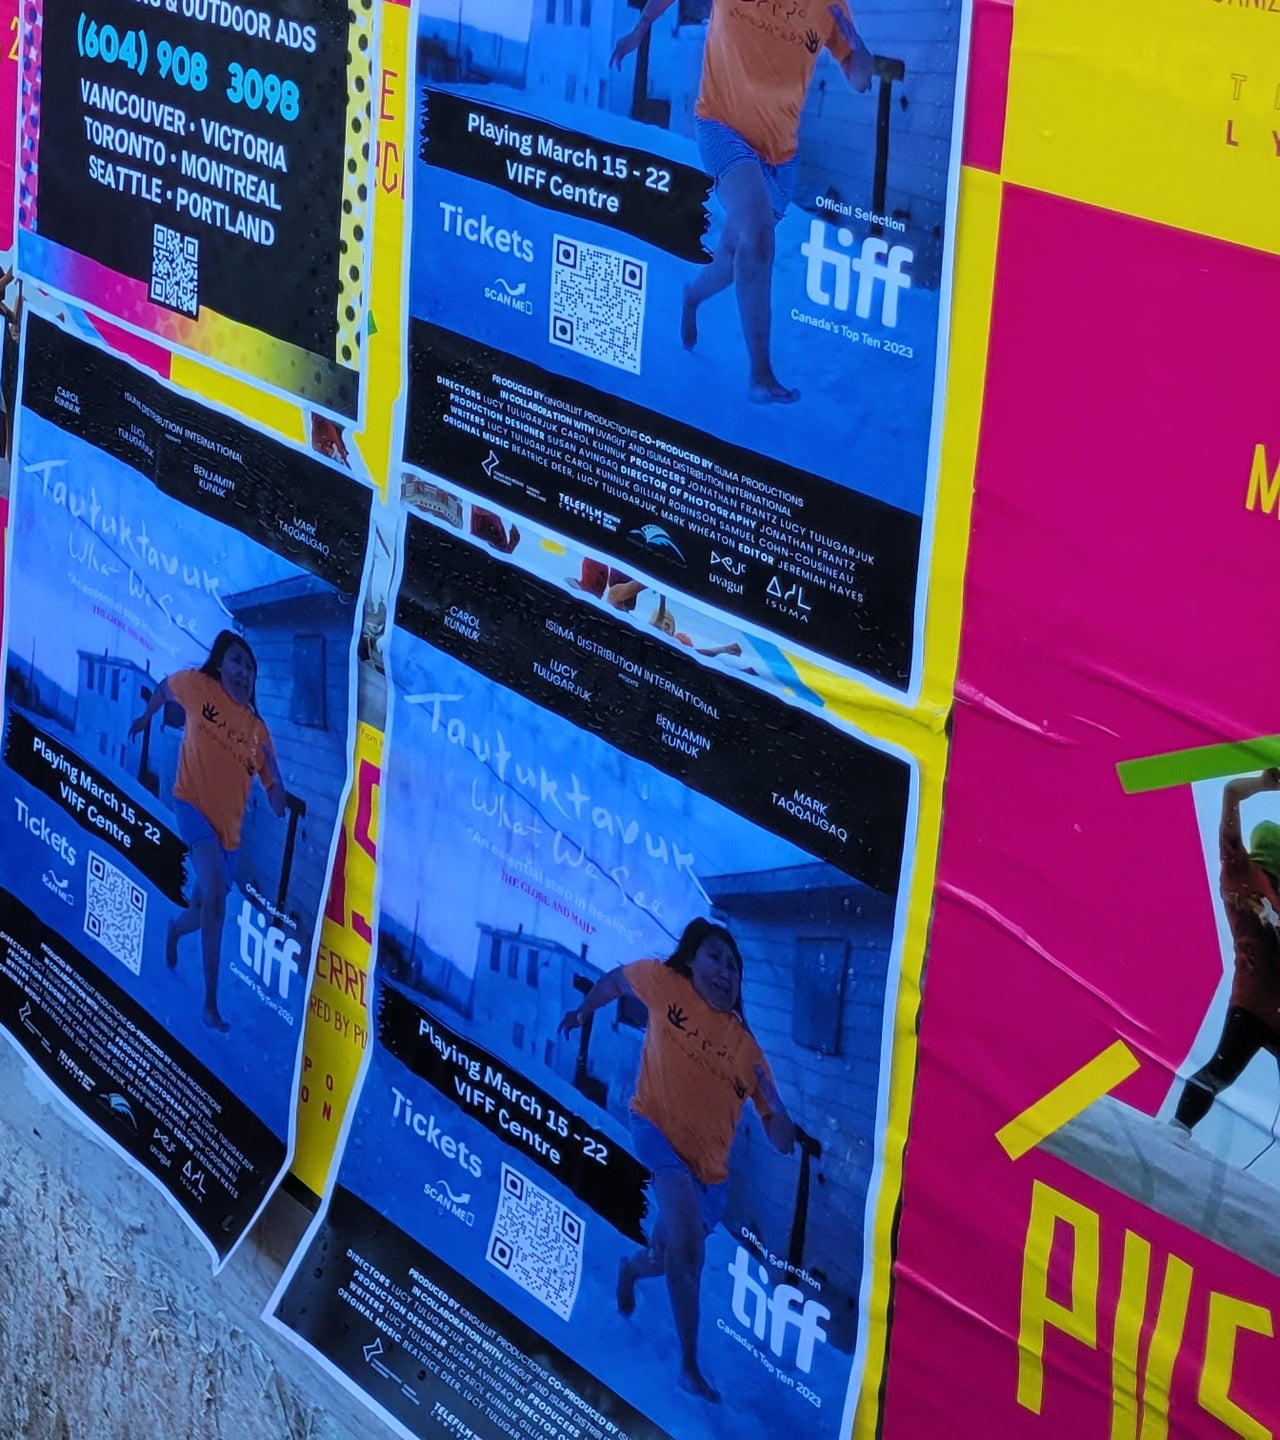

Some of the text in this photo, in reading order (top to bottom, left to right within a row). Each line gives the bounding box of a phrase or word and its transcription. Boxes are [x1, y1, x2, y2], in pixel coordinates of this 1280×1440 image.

[77, 12, 300, 121] (604) 908 3098
[275, 18, 317, 53] ADS
[81, 77, 287, 173] VANCOUVER VICTORIA
[84, 116, 281, 211] TORONTO MONTREAL
[467, 112, 671, 194] Playing March 15 22
[89, 154, 274, 247] SEATTLE PORTLAND
[506, 158, 620, 214] VIFF Centre
[815, 195, 906, 233] Official Selection
[439, 202, 535, 263] Tickets
[801, 218, 914, 328] tiff
[484, 286, 512, 307] SCAN
[790, 308, 914, 359] Canada's Top Ten 2023
[620, 465, 856, 571] DIRECTOR OF PHOTOGRAPHY JONATHAN FRANTZ
[766, 598, 808, 623] ISUMA
[545, 618, 720, 720] ISUMA DISTRIBUTION INTERNATIONAL
[14, 797, 77, 867] Tickets
[59, 781, 132, 849] VIFF Centre
[237, 899, 301, 999] tiff
[390, 1087, 484, 1179] Tickets
[418, 1018, 609, 1166] Playing March 15 22
[454, 1075, 562, 1165] VIFF Centre
[727, 1245, 831, 1374] tiff
